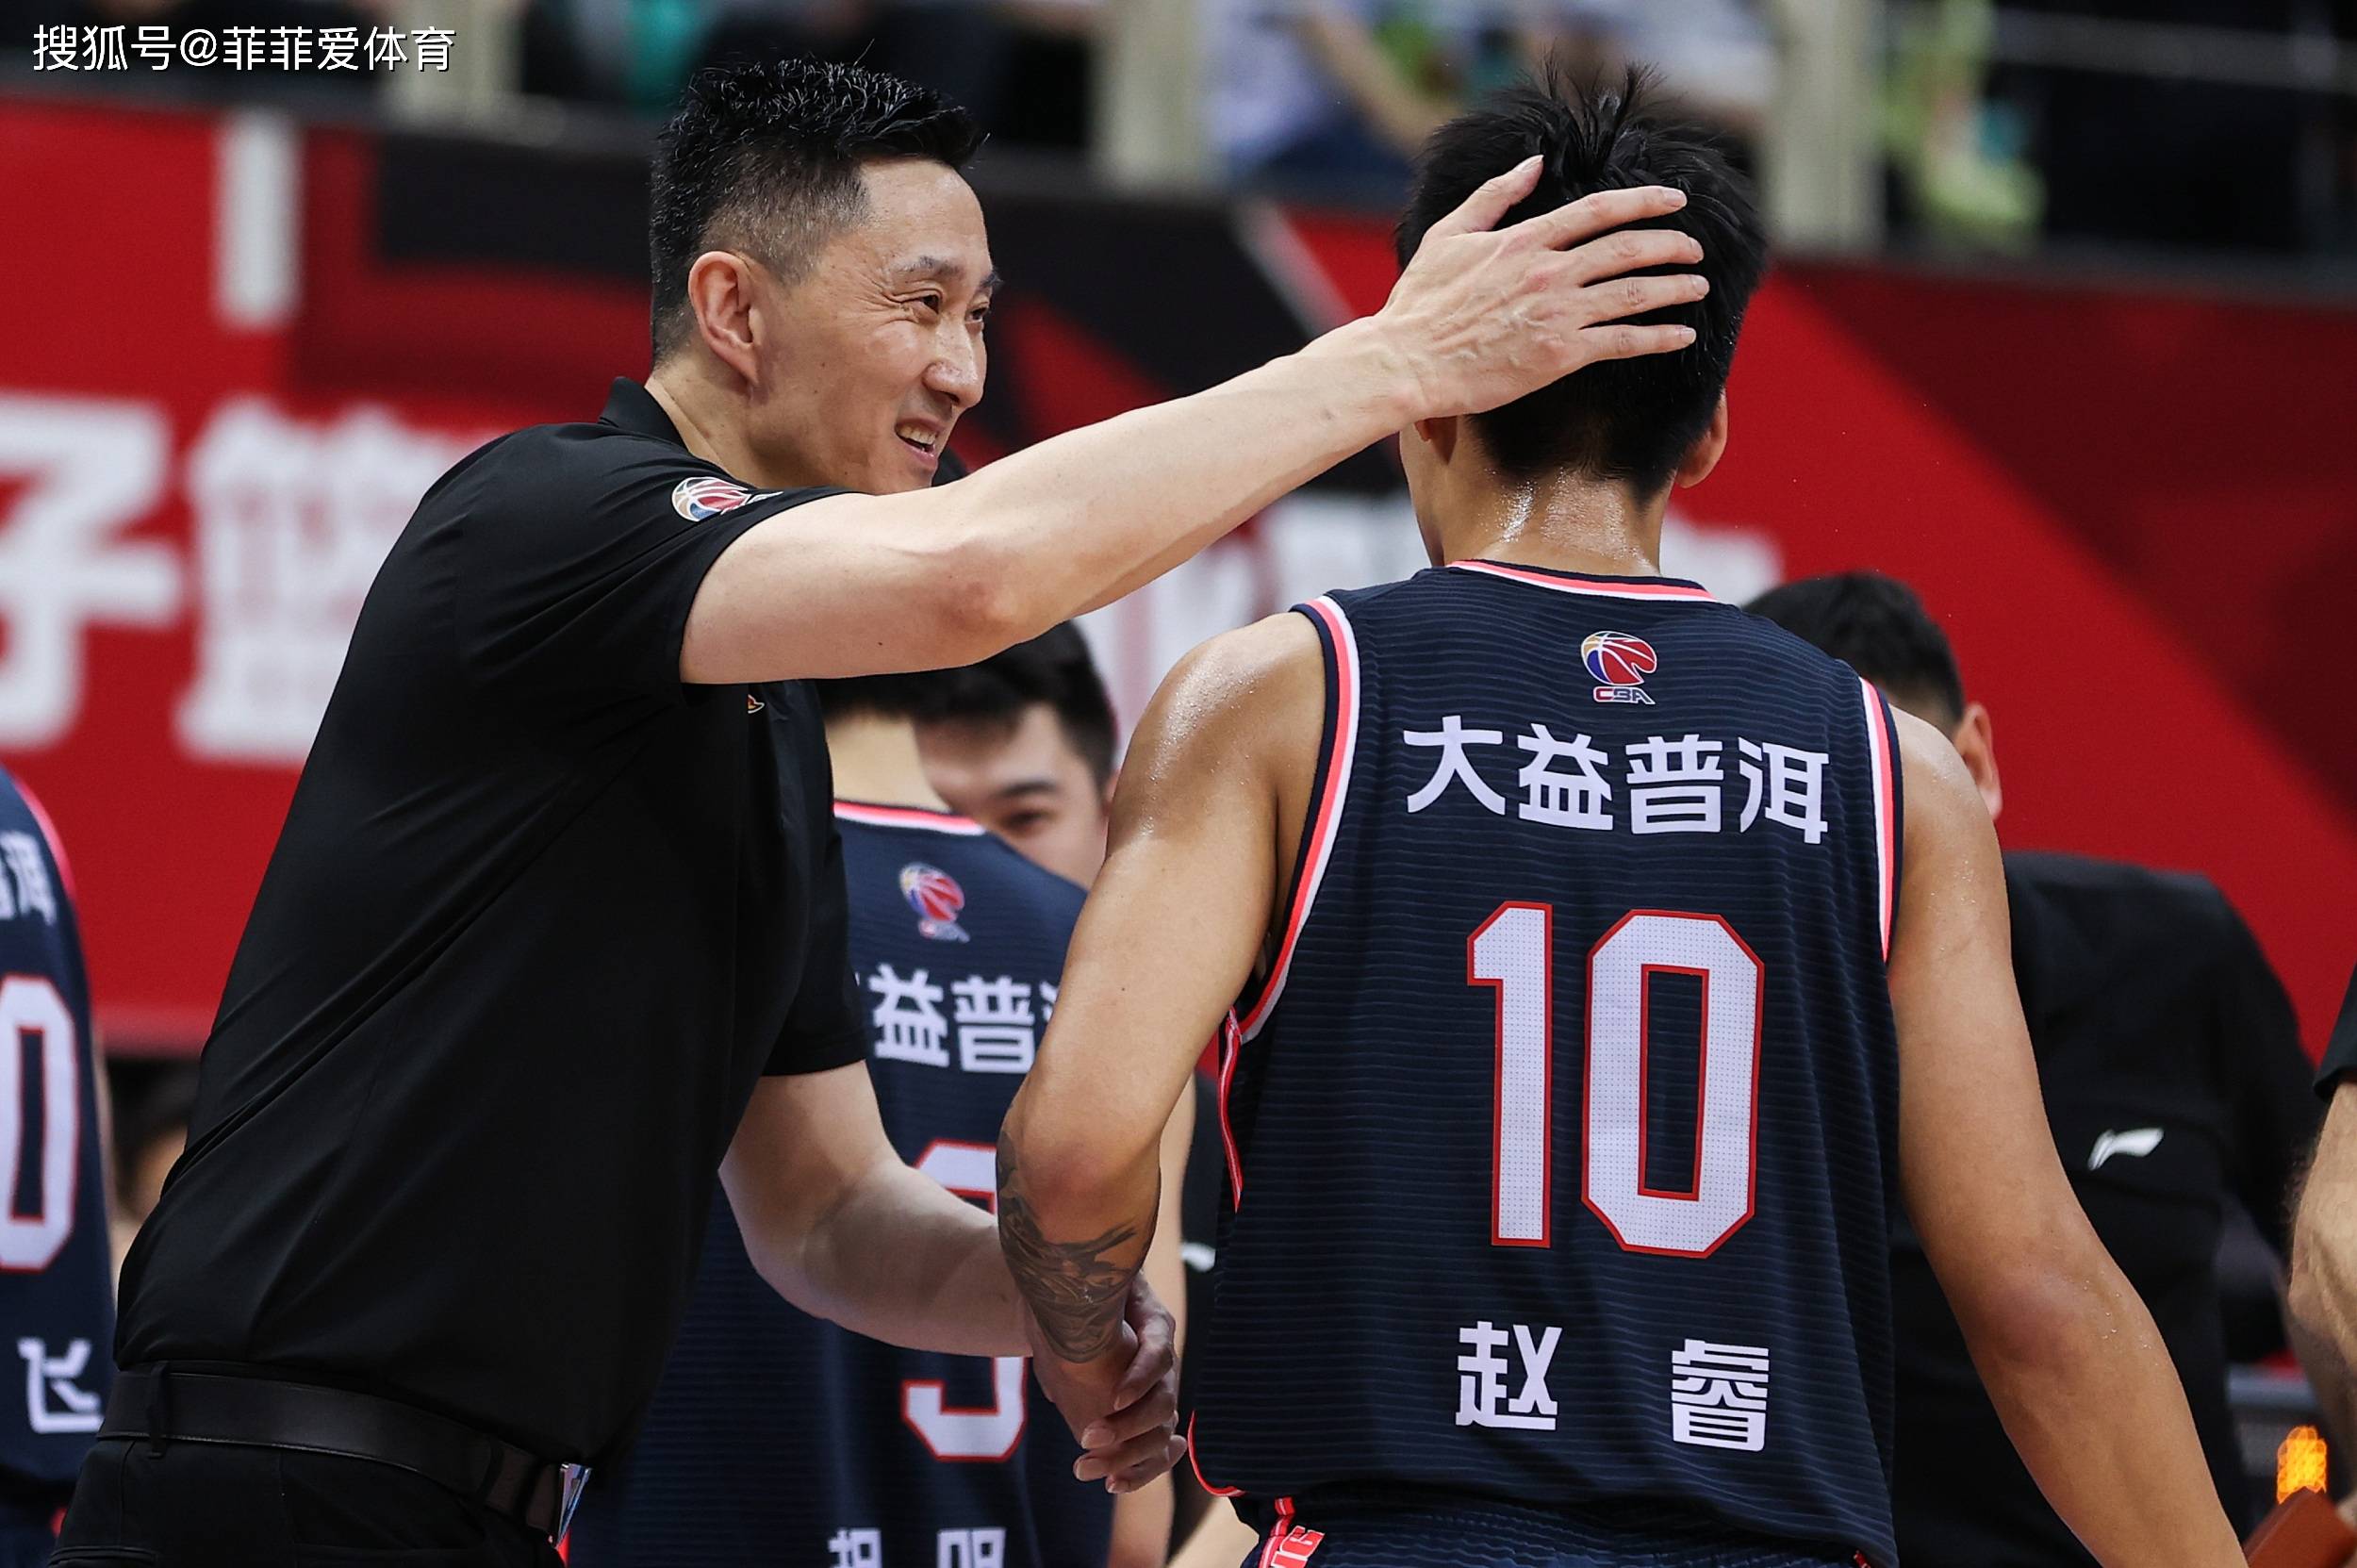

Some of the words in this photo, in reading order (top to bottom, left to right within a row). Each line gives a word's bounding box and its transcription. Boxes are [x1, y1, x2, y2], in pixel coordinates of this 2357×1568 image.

[1593, 685, 1656, 705] CBA
[1402, 714, 1830, 846] 大益普洱
[854, 962, 1060, 1075] 益普
[1466, 900, 1765, 1259] 10
[1455, 1320, 1562, 1431] 赵
[1671, 1339, 1770, 1453] 睿
